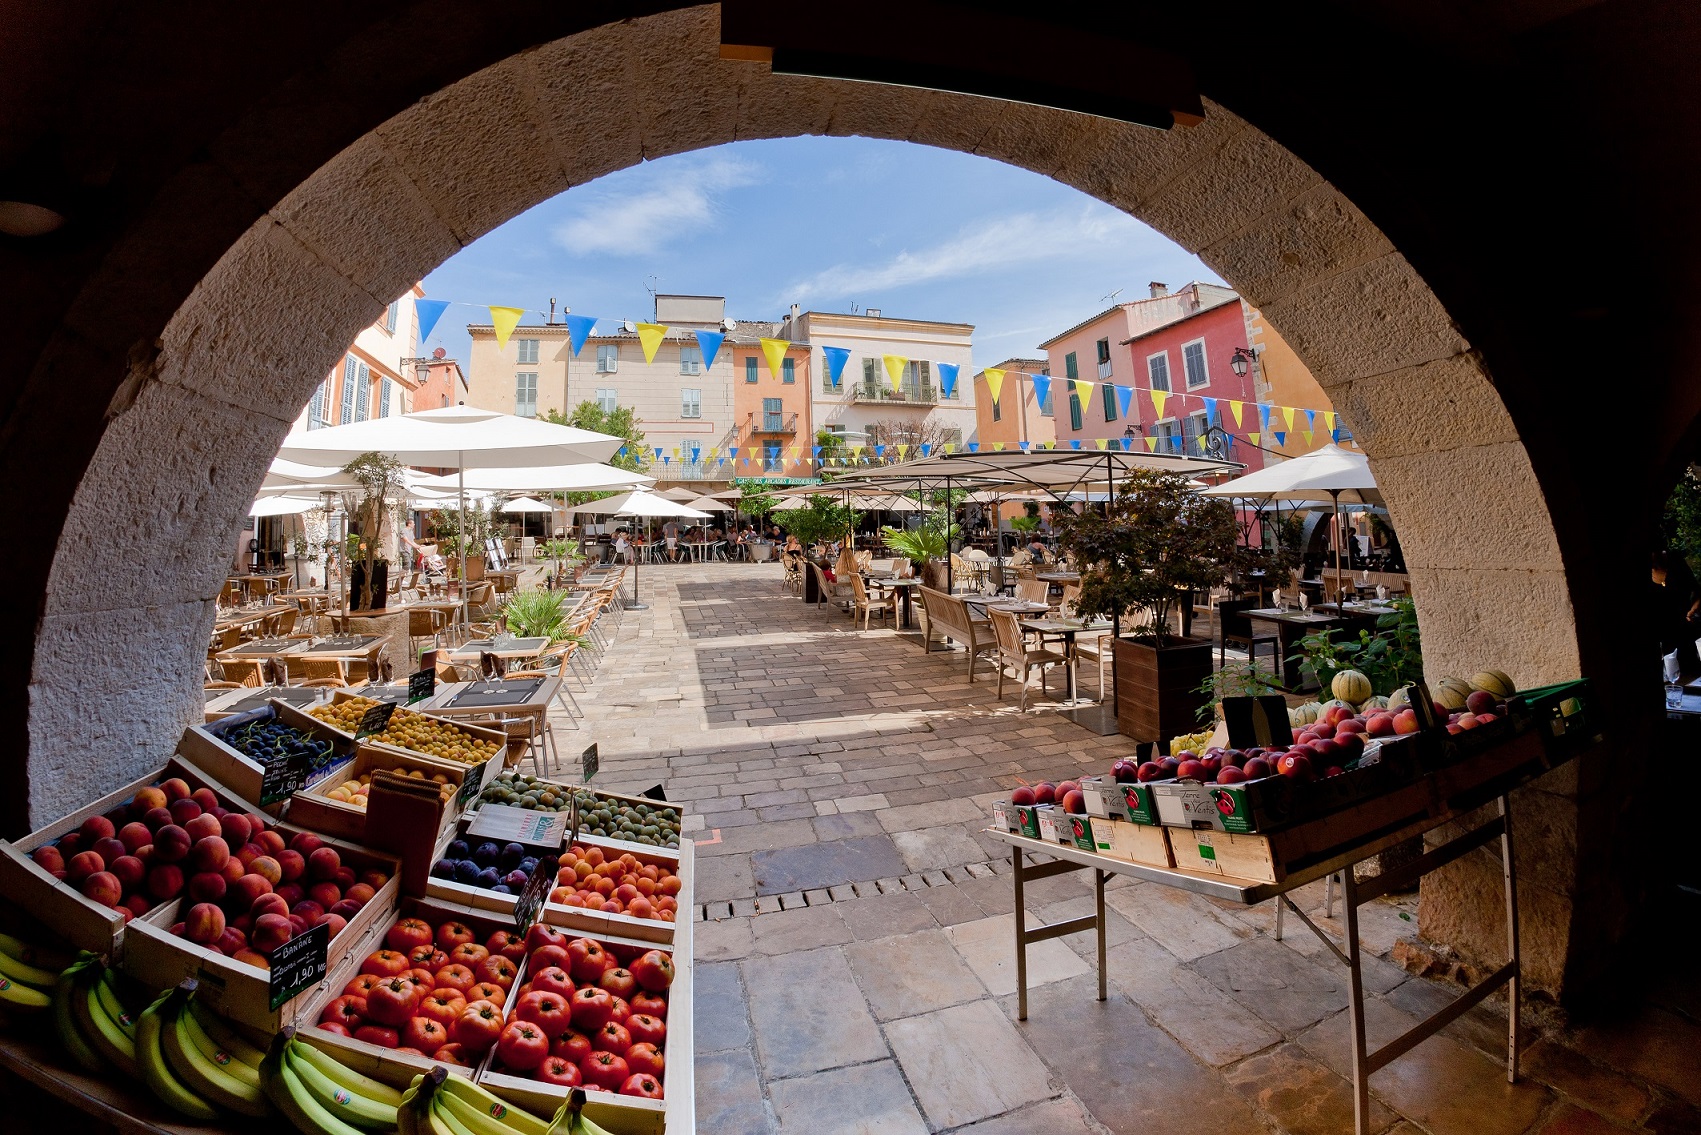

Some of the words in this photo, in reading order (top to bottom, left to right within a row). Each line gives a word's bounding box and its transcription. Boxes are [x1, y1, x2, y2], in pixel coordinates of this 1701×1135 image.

[275, 780, 297, 795] 1,90
[1178, 790, 1200, 799] Terre
[290, 965, 314, 988] 1,90
